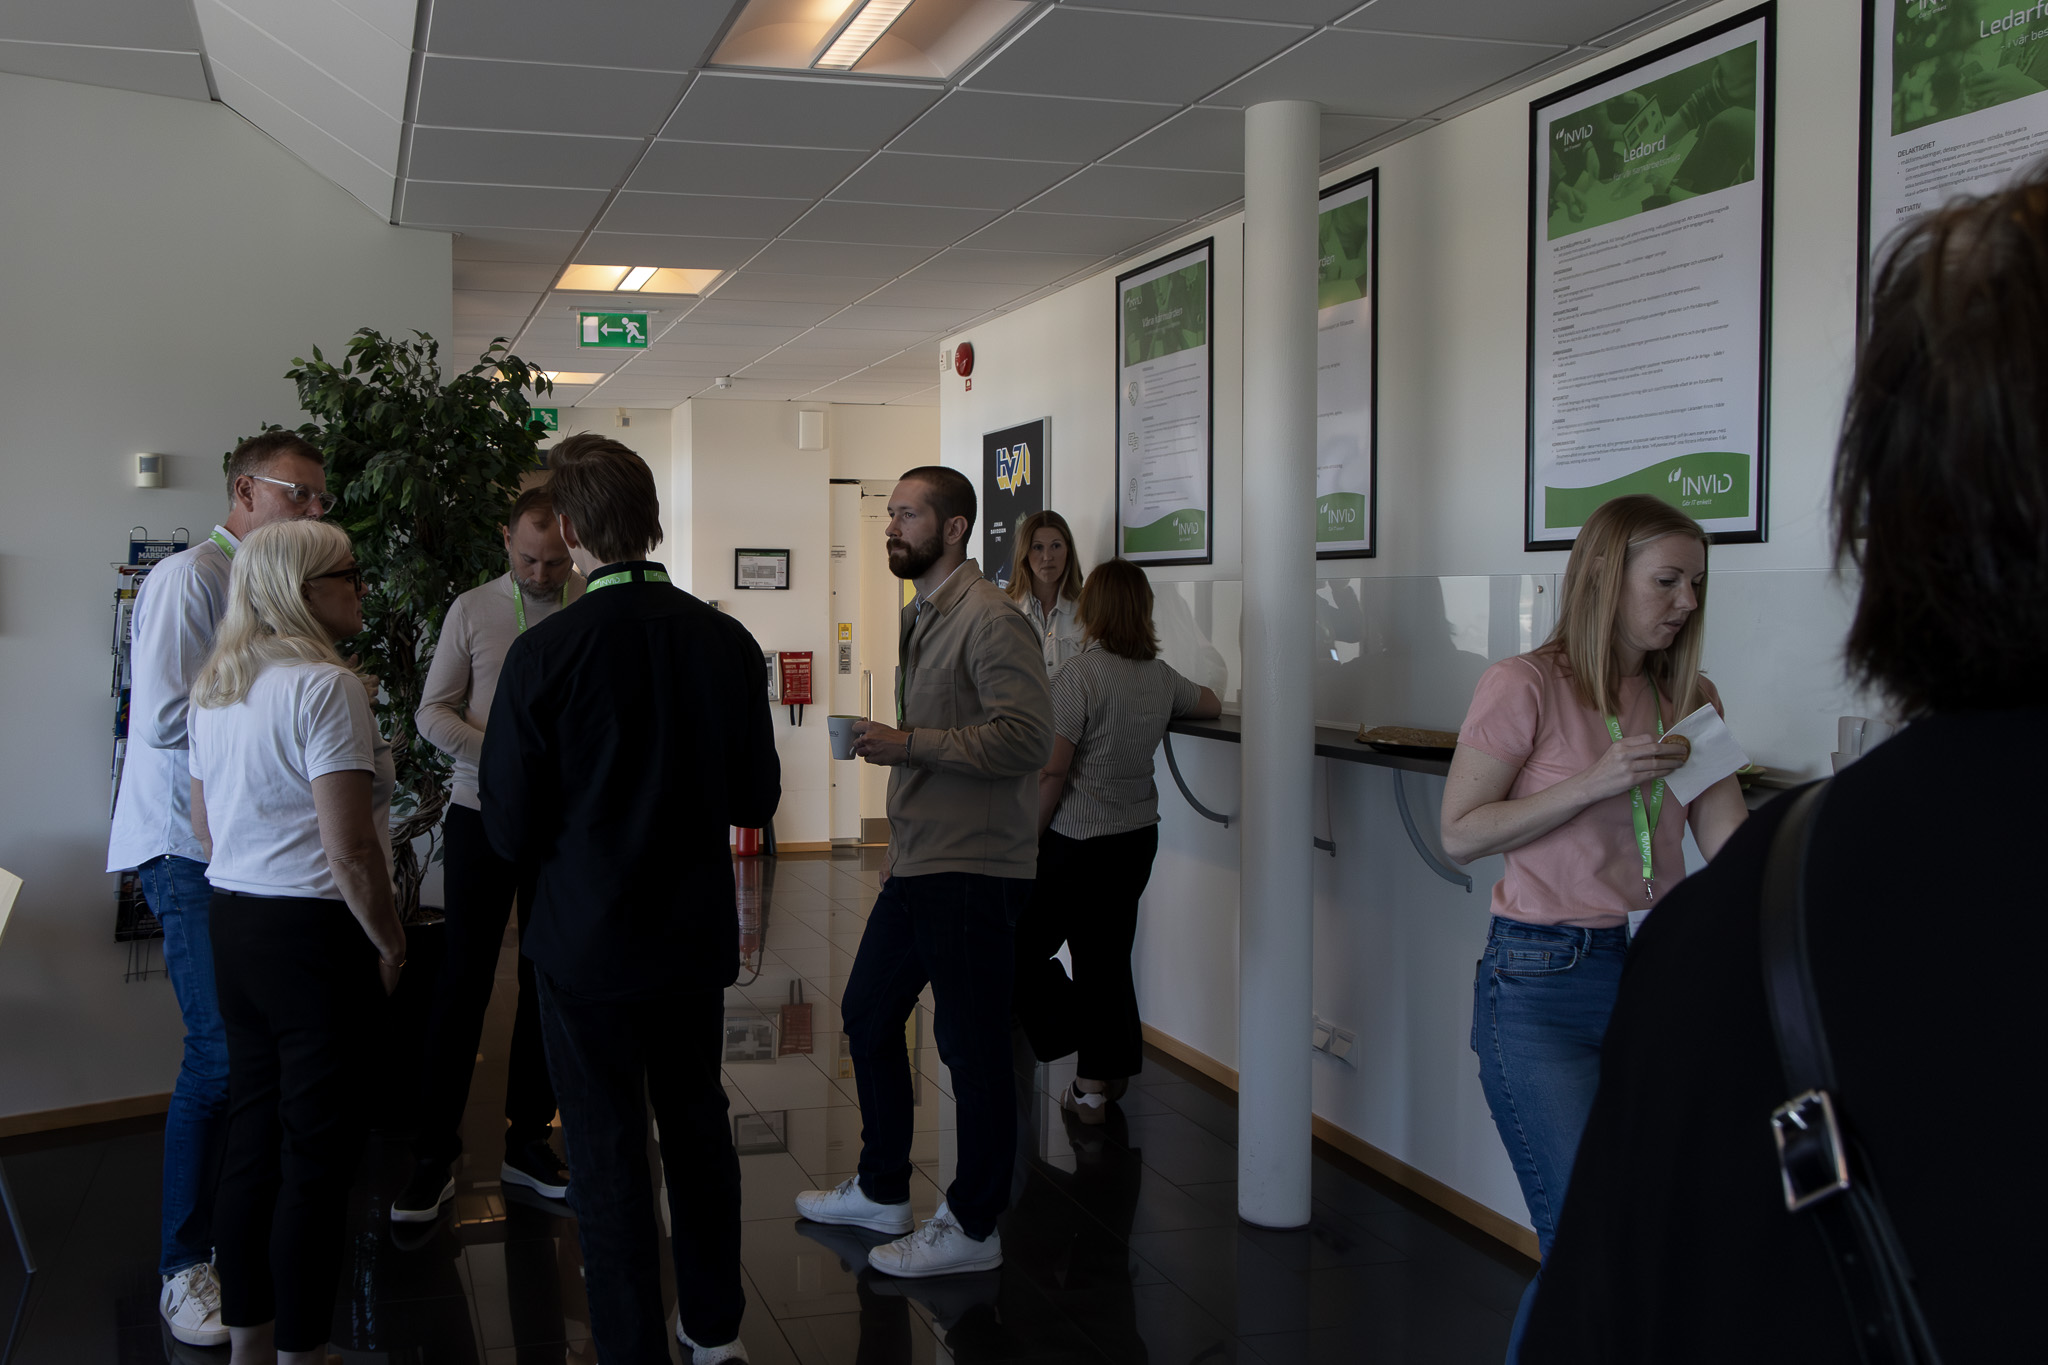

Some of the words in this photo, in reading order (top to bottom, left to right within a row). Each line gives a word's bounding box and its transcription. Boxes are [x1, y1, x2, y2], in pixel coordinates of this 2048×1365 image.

[1564, 124, 1593, 146] INVID
[1624, 134, 1666, 163] Ledord
[1897, 140, 1935, 157] DELAKTIGHET
[1895, 202, 1922, 215] INITIATIV
[996, 442, 1031, 497] HV71
[1682, 473, 1732, 496] INVID
[1328, 508, 1356, 524] INVID
[1178, 521, 1199, 537] INVID
[1640, 831, 1652, 856] INVID
